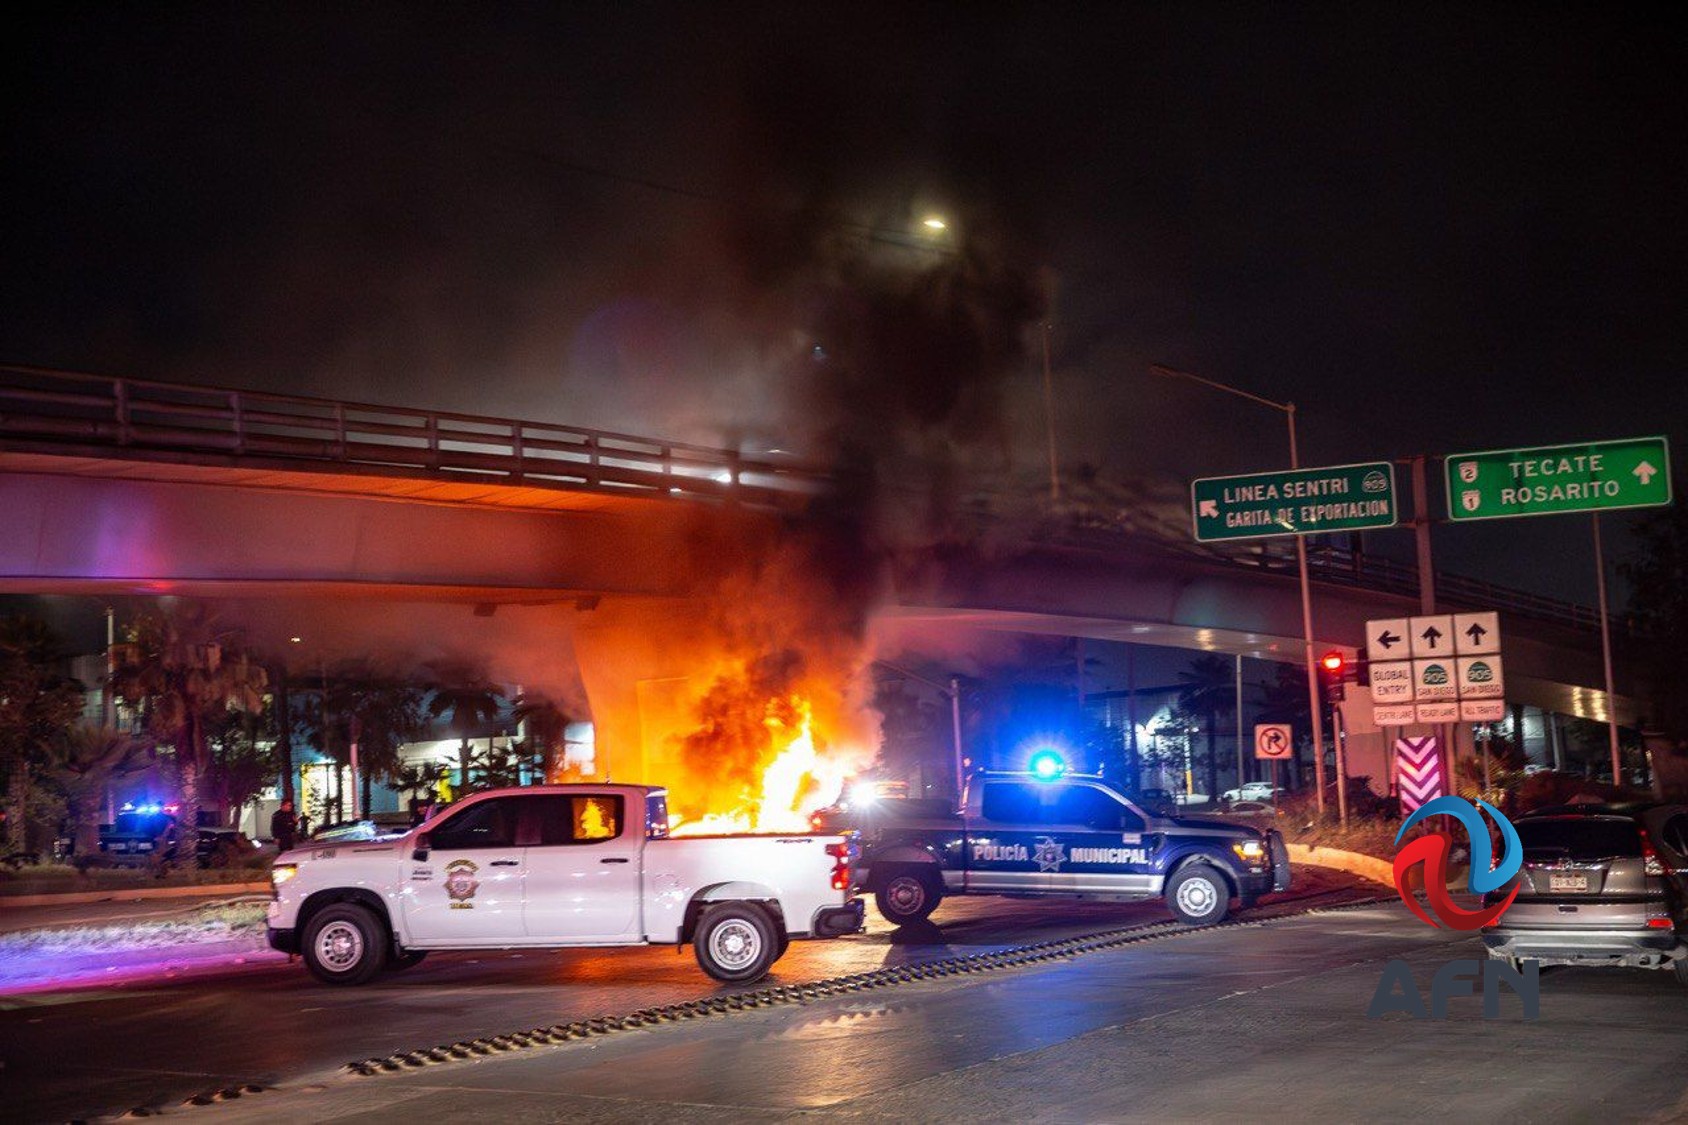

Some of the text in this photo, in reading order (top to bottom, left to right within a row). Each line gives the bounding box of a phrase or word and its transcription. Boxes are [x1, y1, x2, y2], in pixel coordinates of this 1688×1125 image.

[1508, 454, 1604, 478] TECATE
[1224, 477, 1349, 504] LINEA SENTRI
[1501, 480, 1620, 505] ROSARITO
[1226, 509, 1271, 528] GARITA
[1276, 507, 1294, 523] DE
[1374, 670, 1409, 681] GLOBAL
[1423, 672, 1448, 683] 905
[1468, 669, 1493, 680] 905
[1377, 685, 1407, 696] ENTRY
[973, 843, 1149, 864] POLICÍA MUNICIPAL
